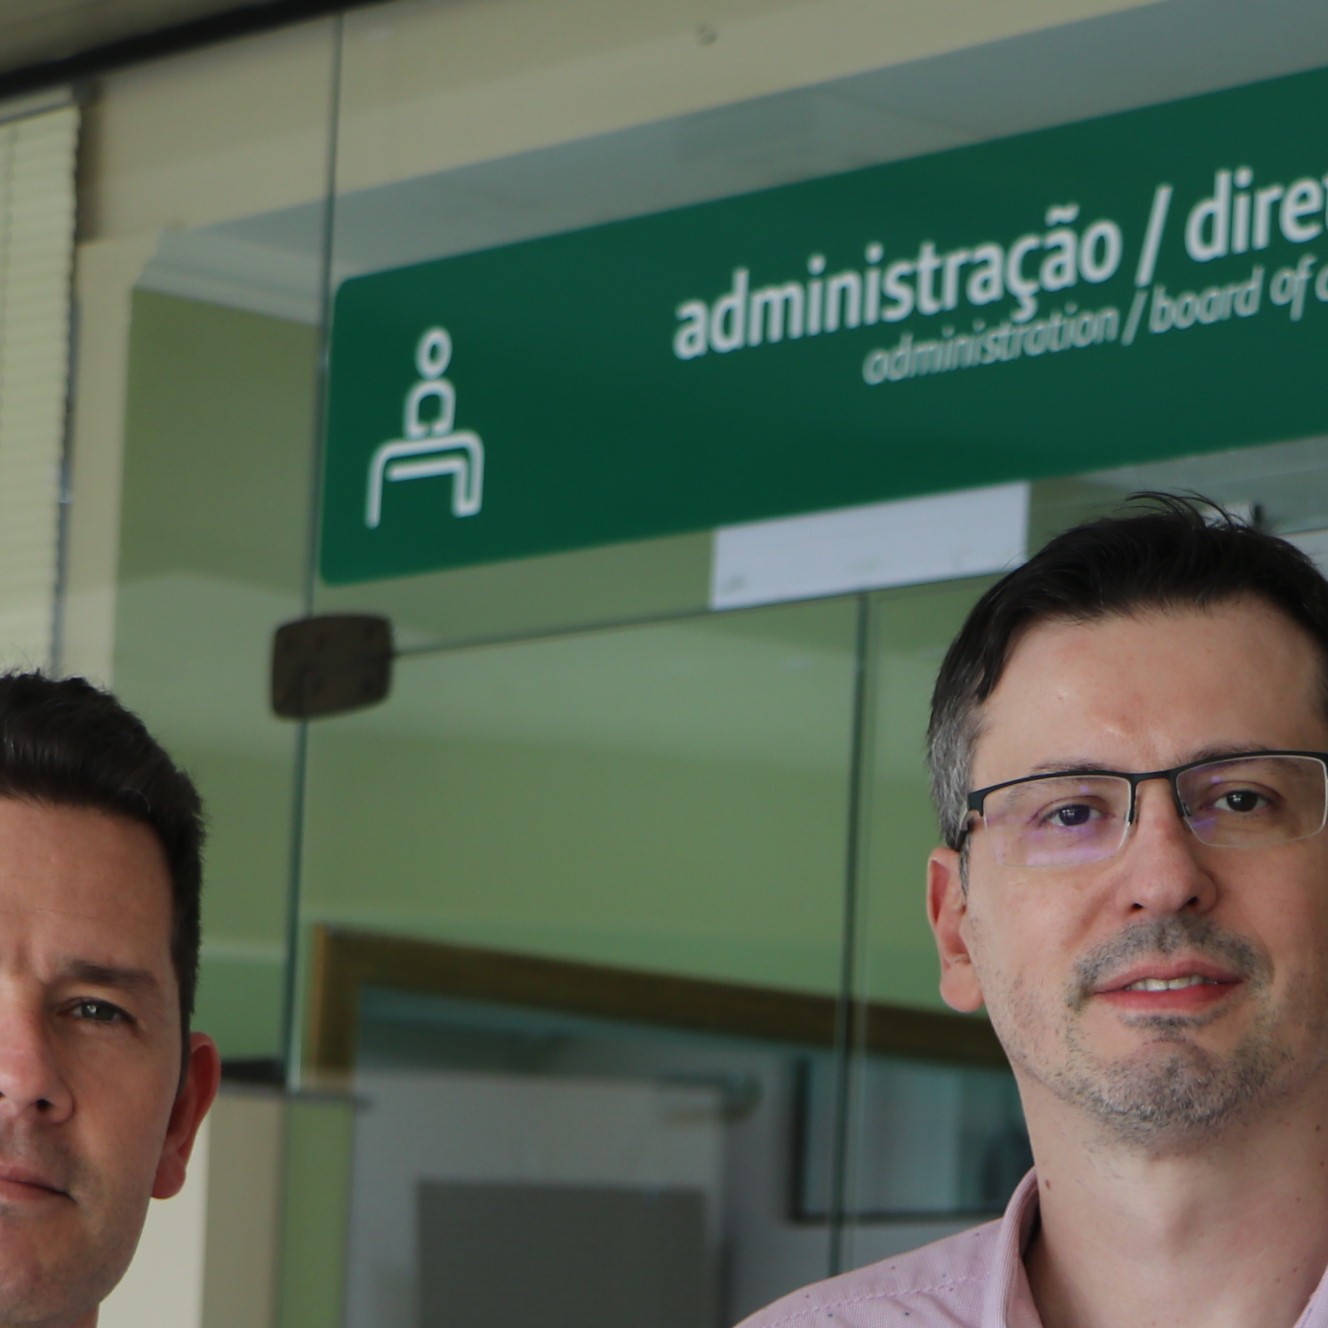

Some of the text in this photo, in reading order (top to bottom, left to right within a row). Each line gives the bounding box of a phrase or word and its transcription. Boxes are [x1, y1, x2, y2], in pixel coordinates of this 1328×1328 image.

[673, 205, 1122, 360] administração
[863, 302, 1120, 386] administration
[1149, 264, 1264, 334] board
[1269, 254, 1317, 322] of
